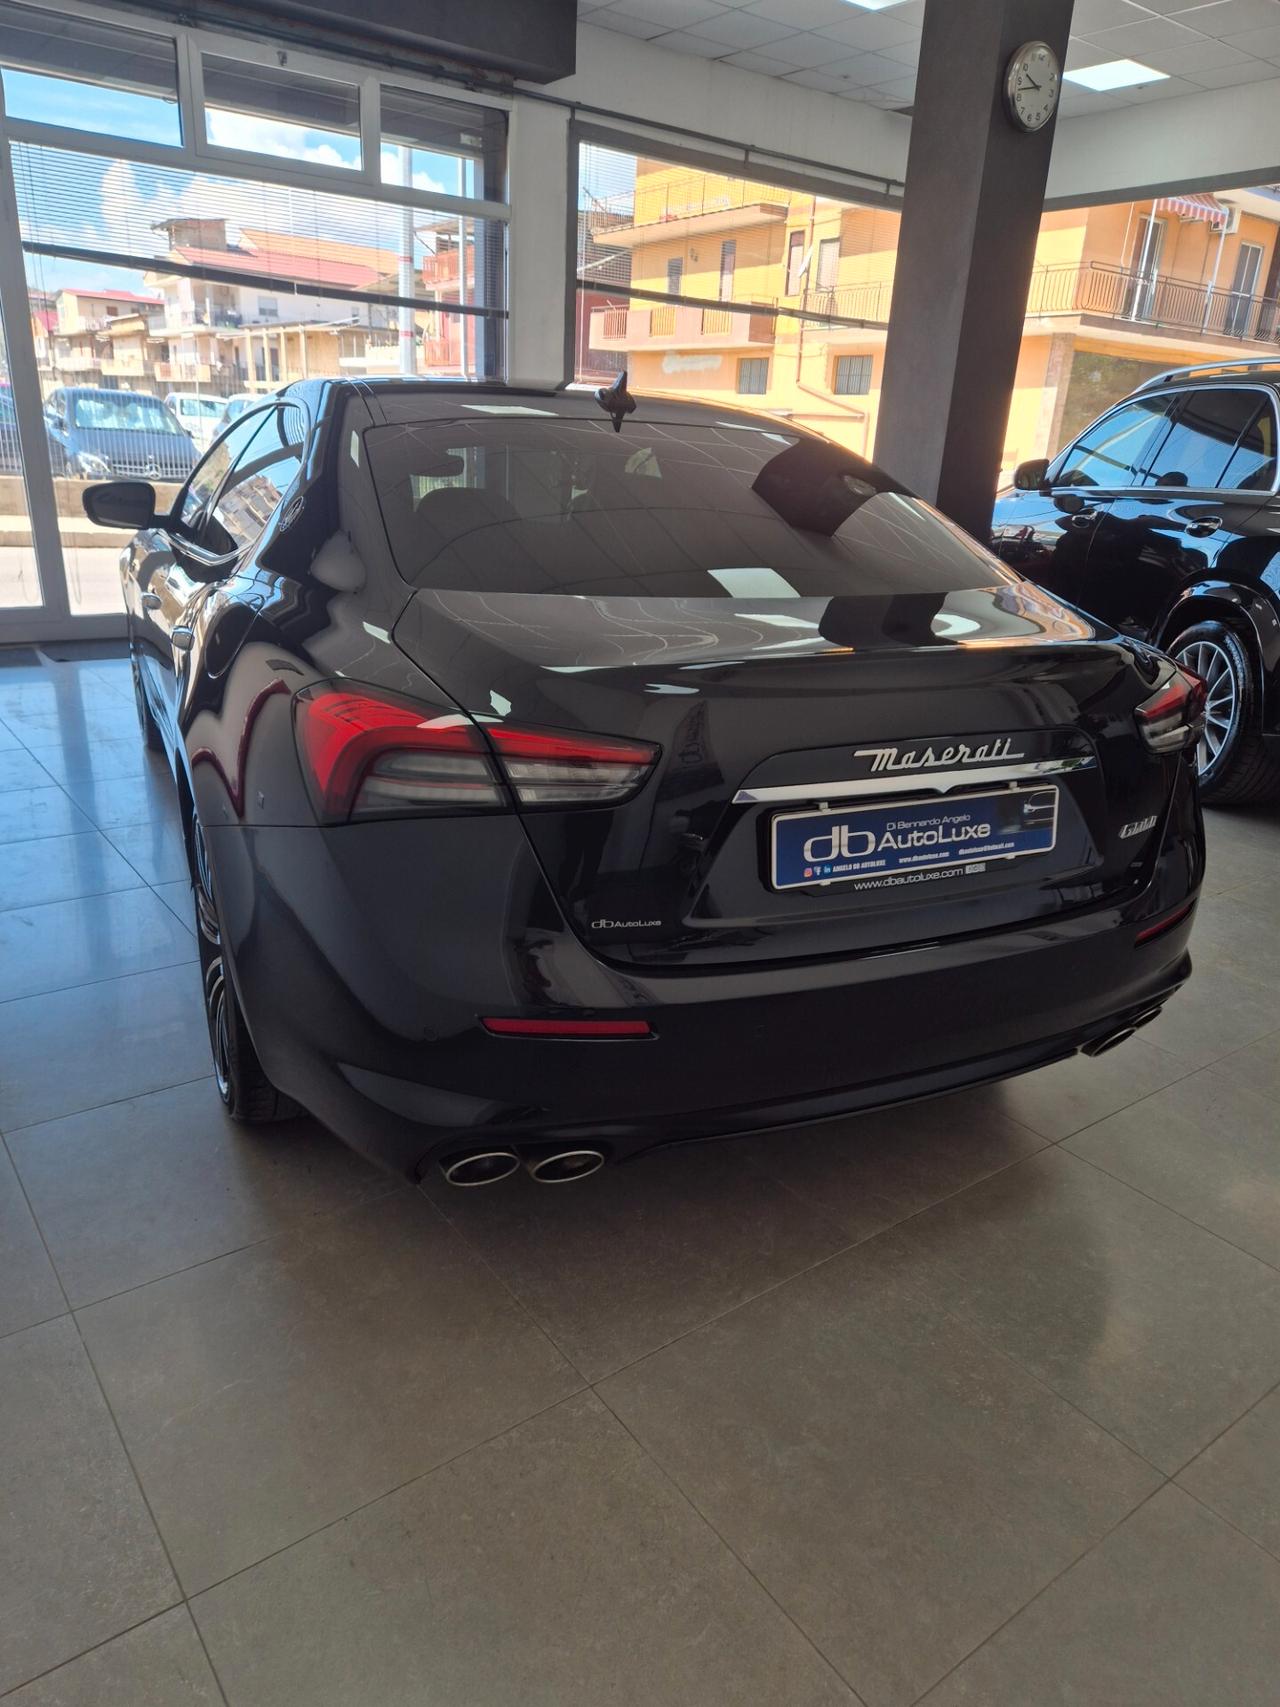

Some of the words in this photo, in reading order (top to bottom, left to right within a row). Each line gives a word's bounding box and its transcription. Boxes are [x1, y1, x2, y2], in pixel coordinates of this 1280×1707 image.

[854, 738, 1025, 772] Maserati
[942, 814, 971, 826] Angelo
[877, 823, 991, 852] AutoLuxe
[854, 867, 964, 891] www.dbautoluxe.com
